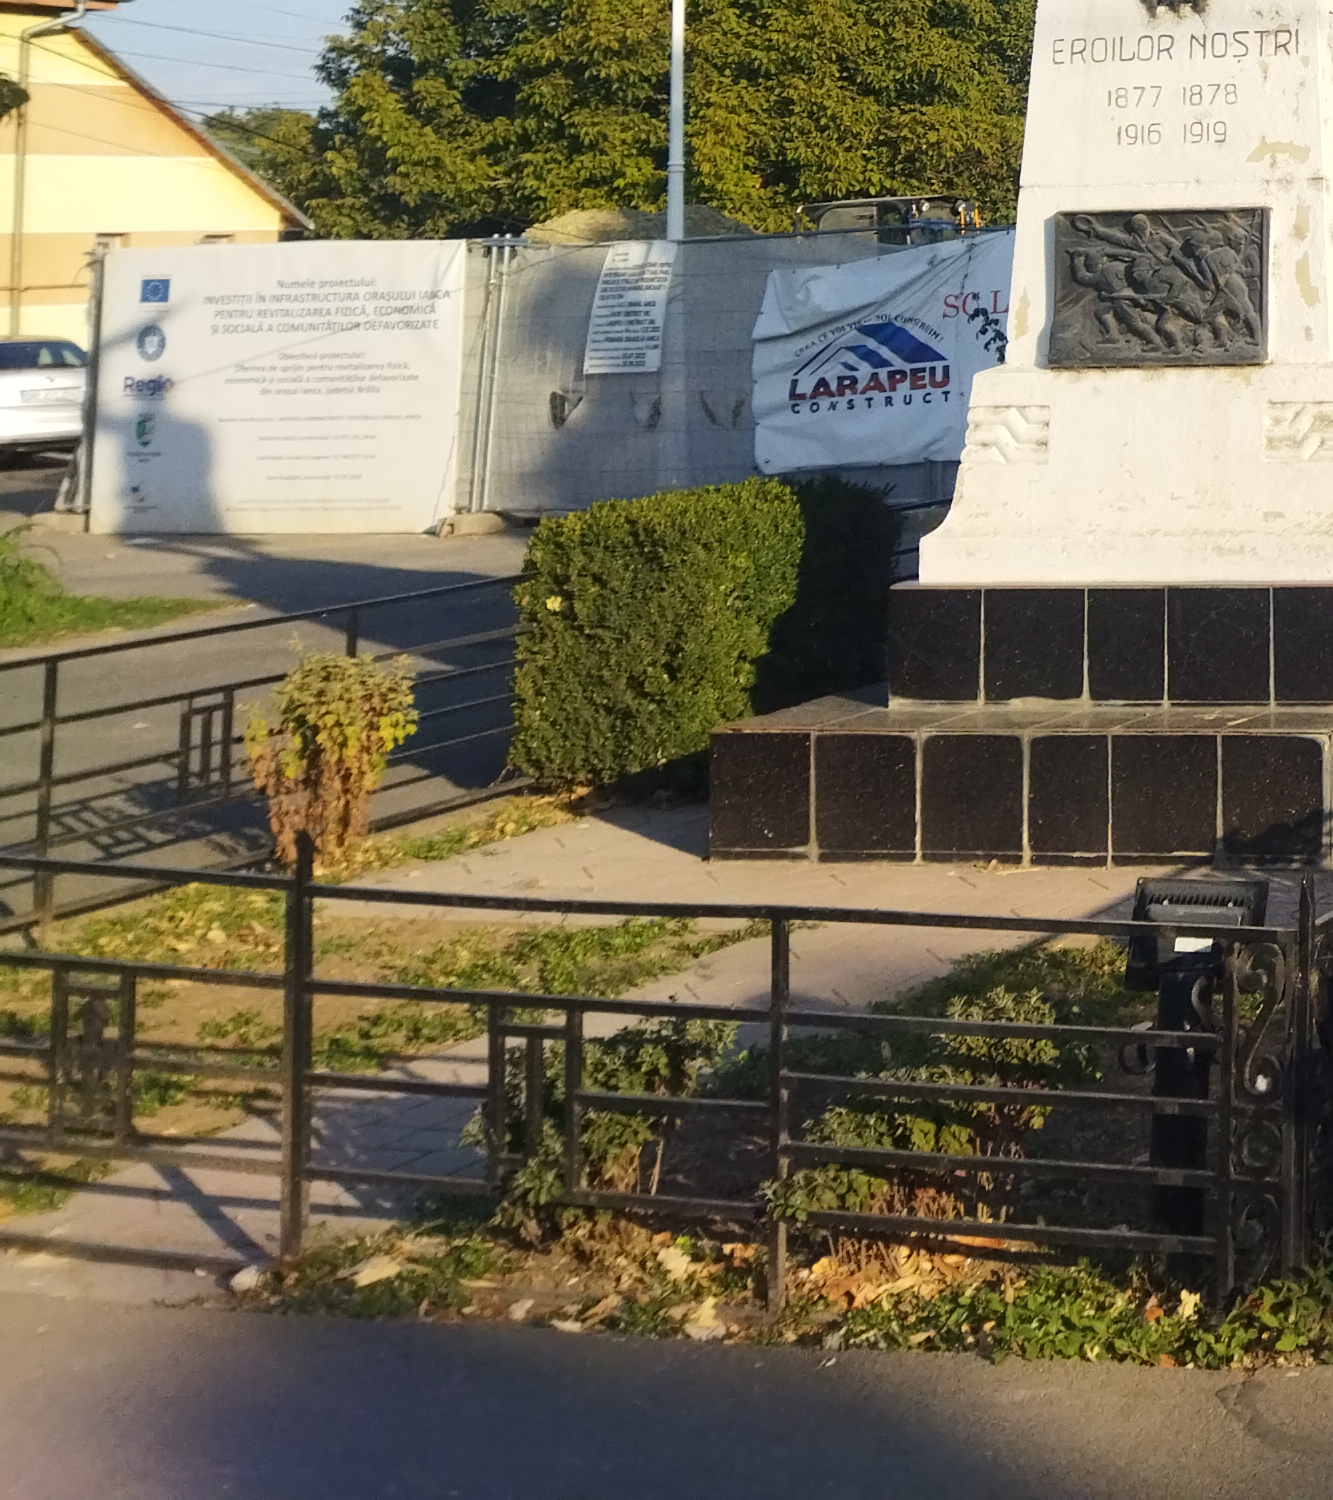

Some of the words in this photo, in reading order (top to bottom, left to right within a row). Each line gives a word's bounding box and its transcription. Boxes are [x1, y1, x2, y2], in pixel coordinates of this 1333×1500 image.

[1052, 34, 1175, 65] EROILOR
[1107, 85, 1163, 109] 1877
[1182, 83, 1238, 107] 1878
[1117, 122, 1162, 146] 1916
[1183, 120, 1227, 145] 1919
[277, 278, 316, 289] Numele
[319, 276, 377, 290] proiectului:
[269, 292, 360, 304] INFRASTRUCTURA
[942, 291, 981, 319] SC
[990, 290, 1009, 315] L
[256, 307, 332, 319] REVITALIZAREA
[363, 319, 439, 331] DEFAVORIZATE
[122, 375, 174, 397] Regio
[789, 365, 951, 401] LARAPEU
[791, 390, 951, 414] CONSTRUCT
